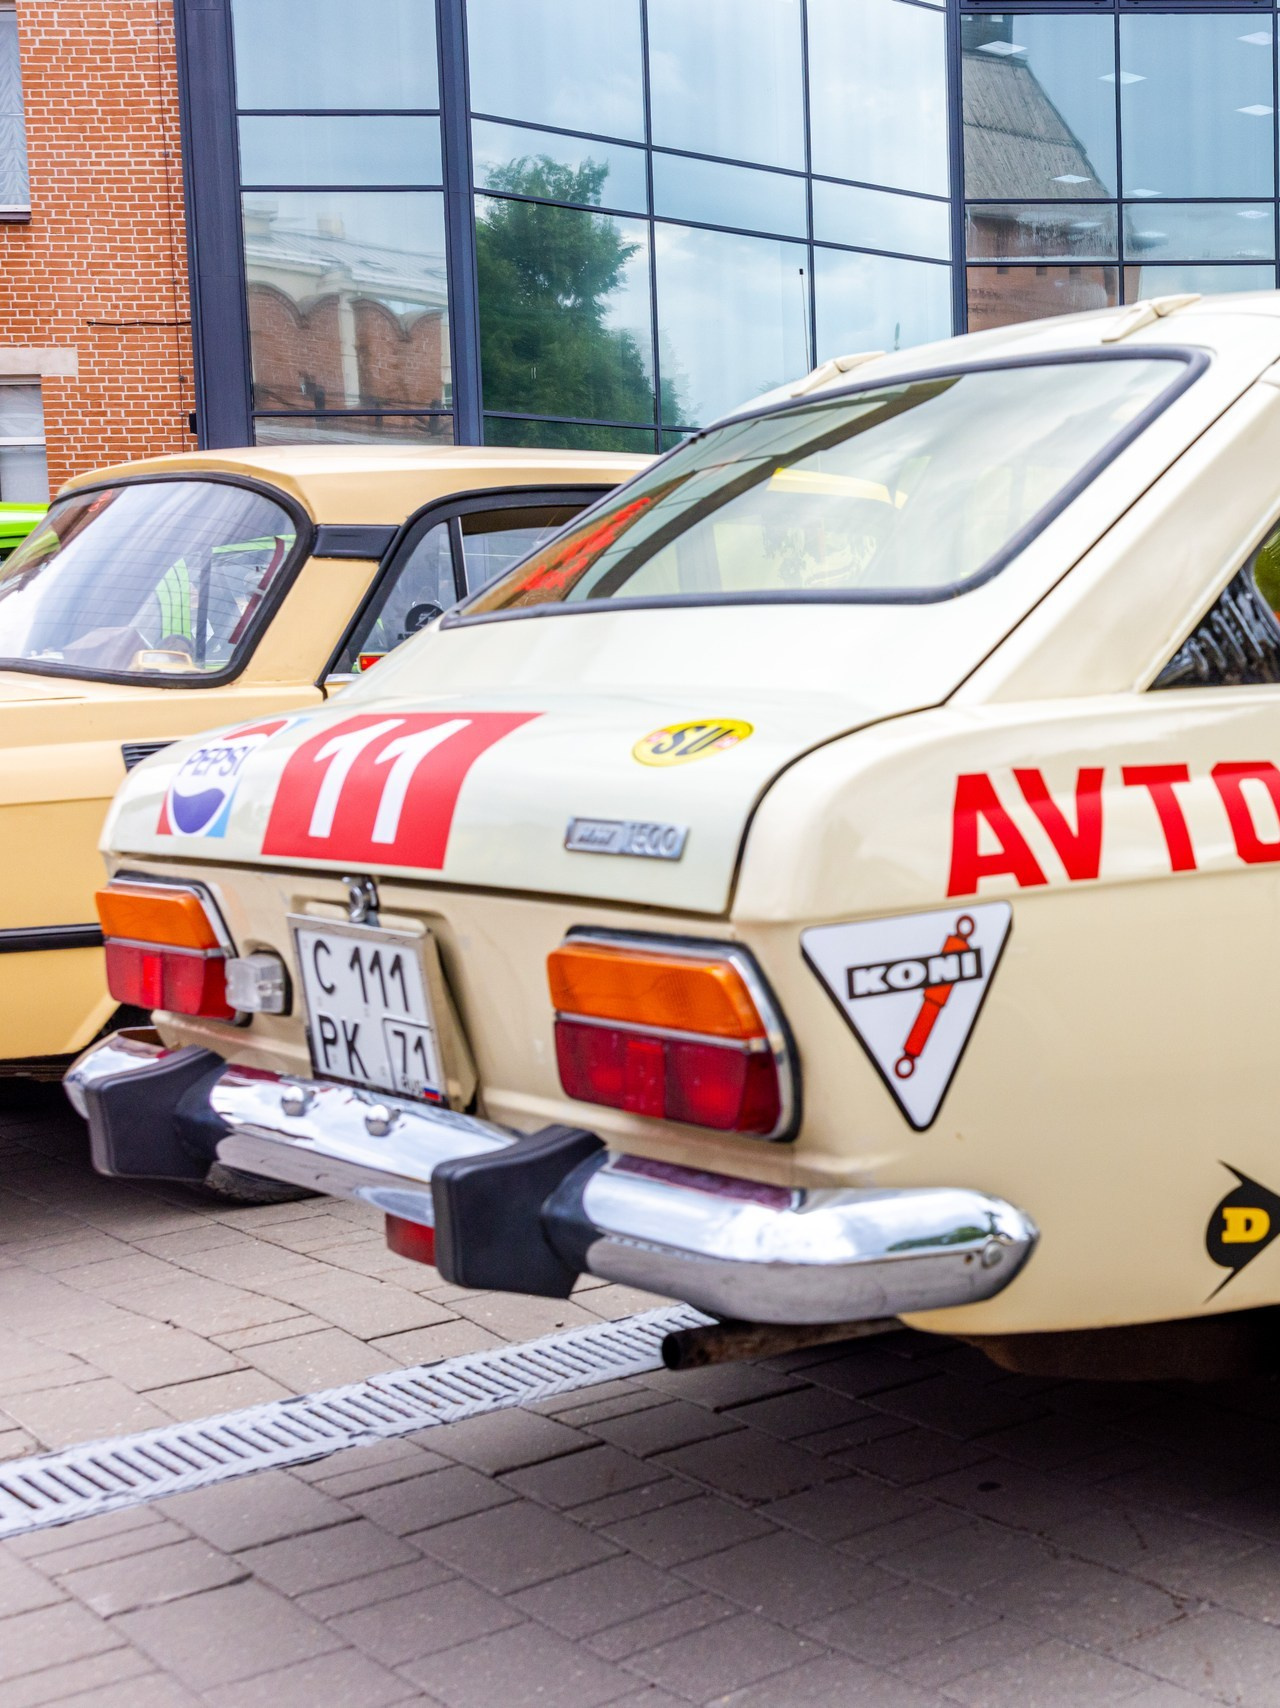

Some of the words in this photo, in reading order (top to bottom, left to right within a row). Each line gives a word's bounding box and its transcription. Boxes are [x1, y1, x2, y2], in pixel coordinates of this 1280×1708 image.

[178, 746, 256, 777] PEPSI
[308, 718, 473, 845] 11
[852, 951, 978, 997] KONI
[393, 1029, 430, 1082] 71
[1221, 1206, 1270, 1244] D
